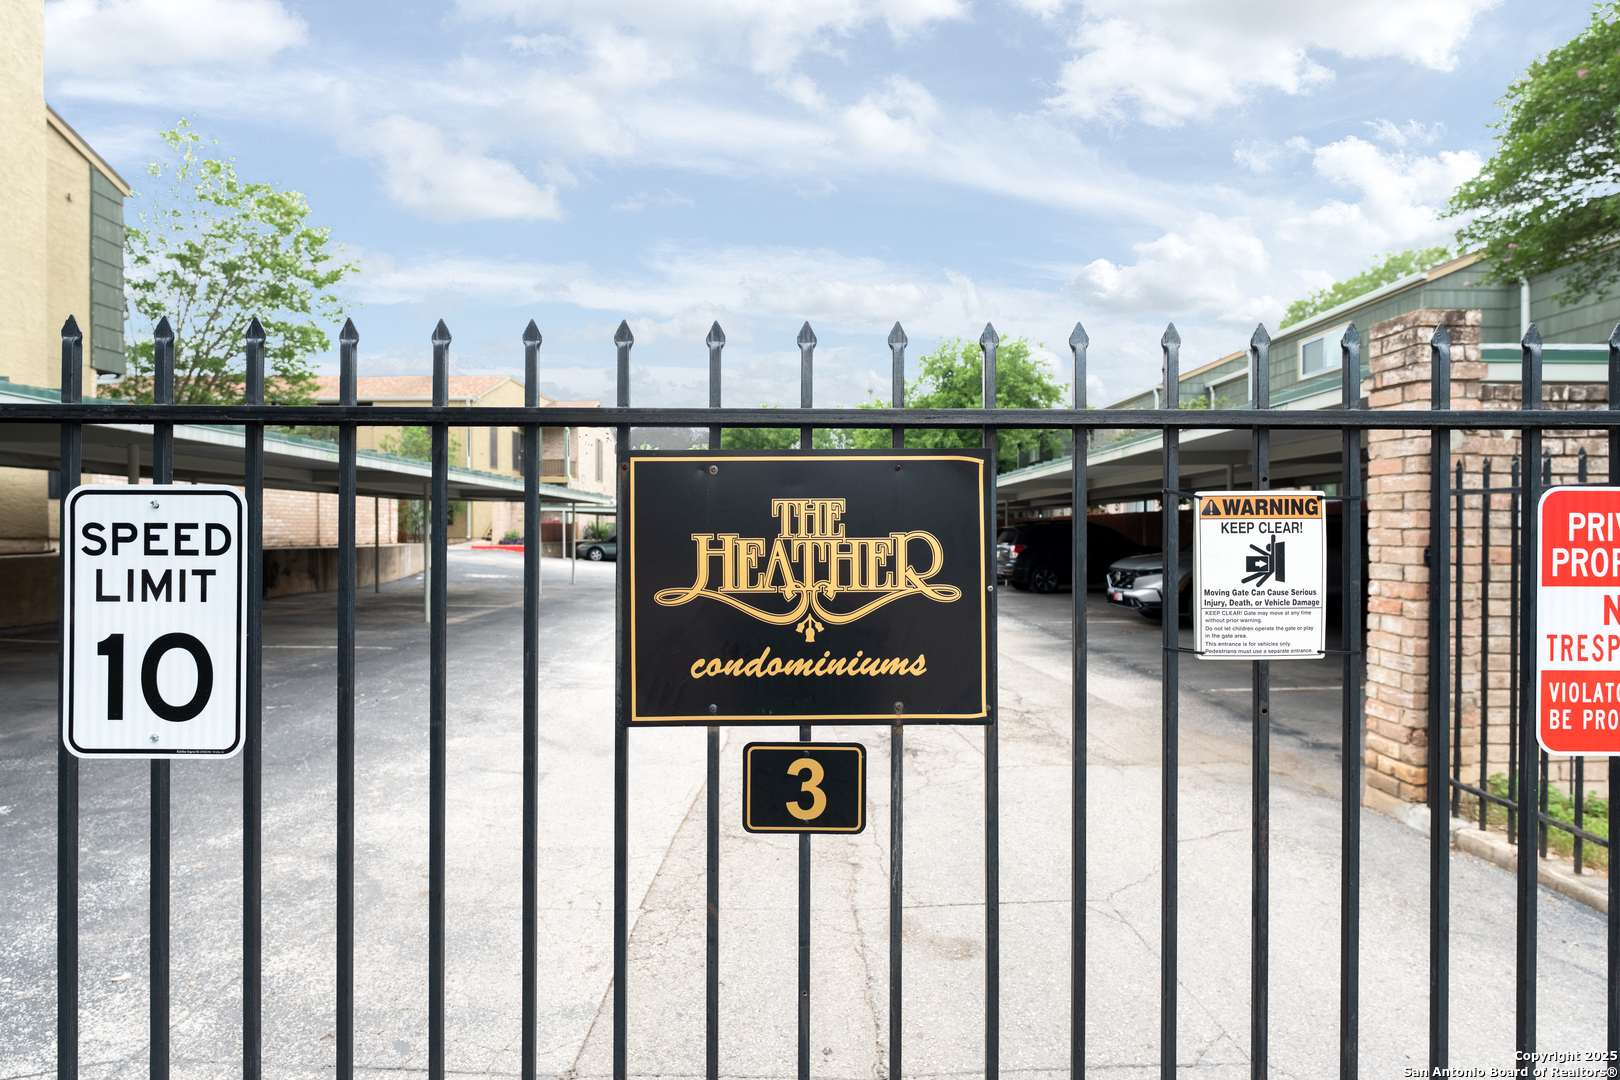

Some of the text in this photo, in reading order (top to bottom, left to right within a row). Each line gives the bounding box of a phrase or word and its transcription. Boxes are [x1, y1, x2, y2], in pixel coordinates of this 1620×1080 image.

[772, 498, 845, 538] THE
[1223, 498, 1318, 516] WARNING
[81, 522, 232, 556] SPEED
[1221, 522, 1303, 534] KEEP CLEAR!
[96, 569, 216, 602] LIMIT
[654, 530, 962, 609] HEATHER
[97, 632, 213, 722] 10
[691, 647, 927, 679] condominiums
[1550, 709, 1571, 729] BE
[786, 758, 827, 820] 3
